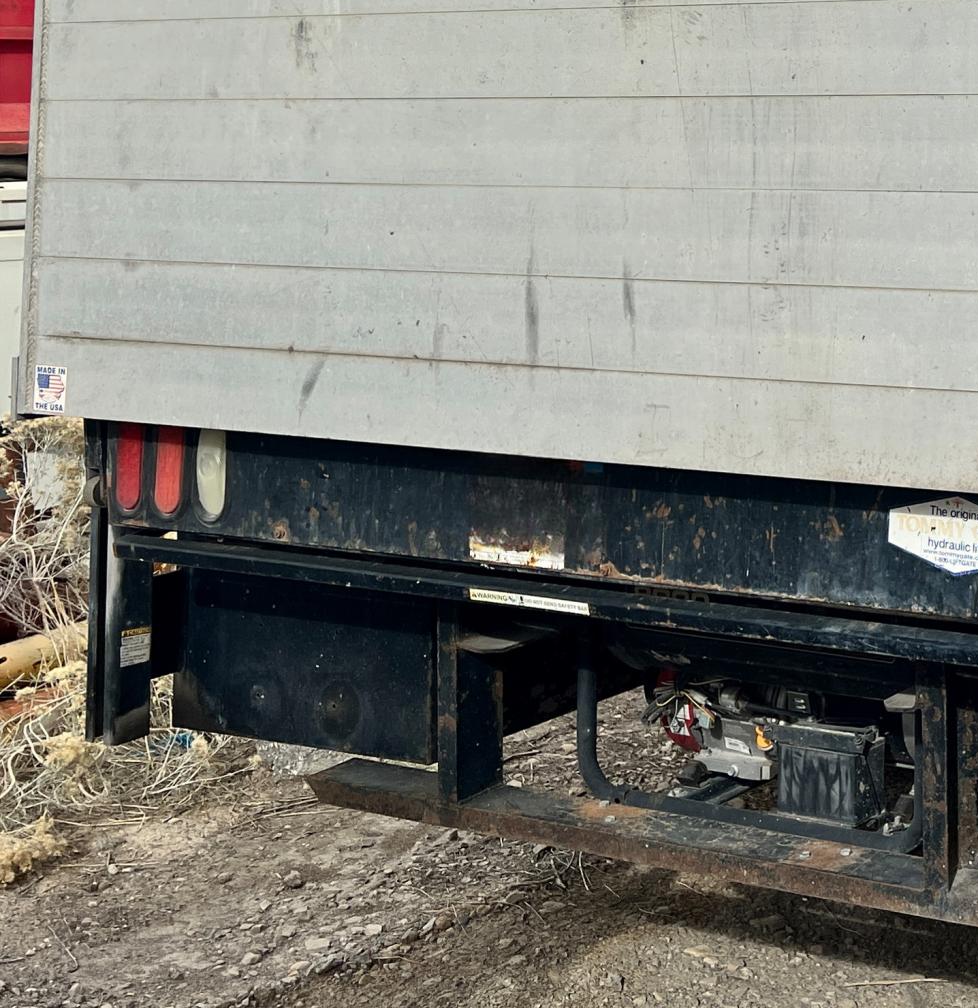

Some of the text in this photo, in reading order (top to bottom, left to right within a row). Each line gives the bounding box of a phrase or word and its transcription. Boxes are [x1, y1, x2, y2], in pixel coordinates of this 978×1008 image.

[37, 366, 56, 374] MADE
[35, 402, 48, 410] THE
[930, 505, 948, 518] The
[897, 514, 964, 538] TOMMY
[928, 537, 971, 552] hydraulic
[477, 591, 508, 601] WARNING
